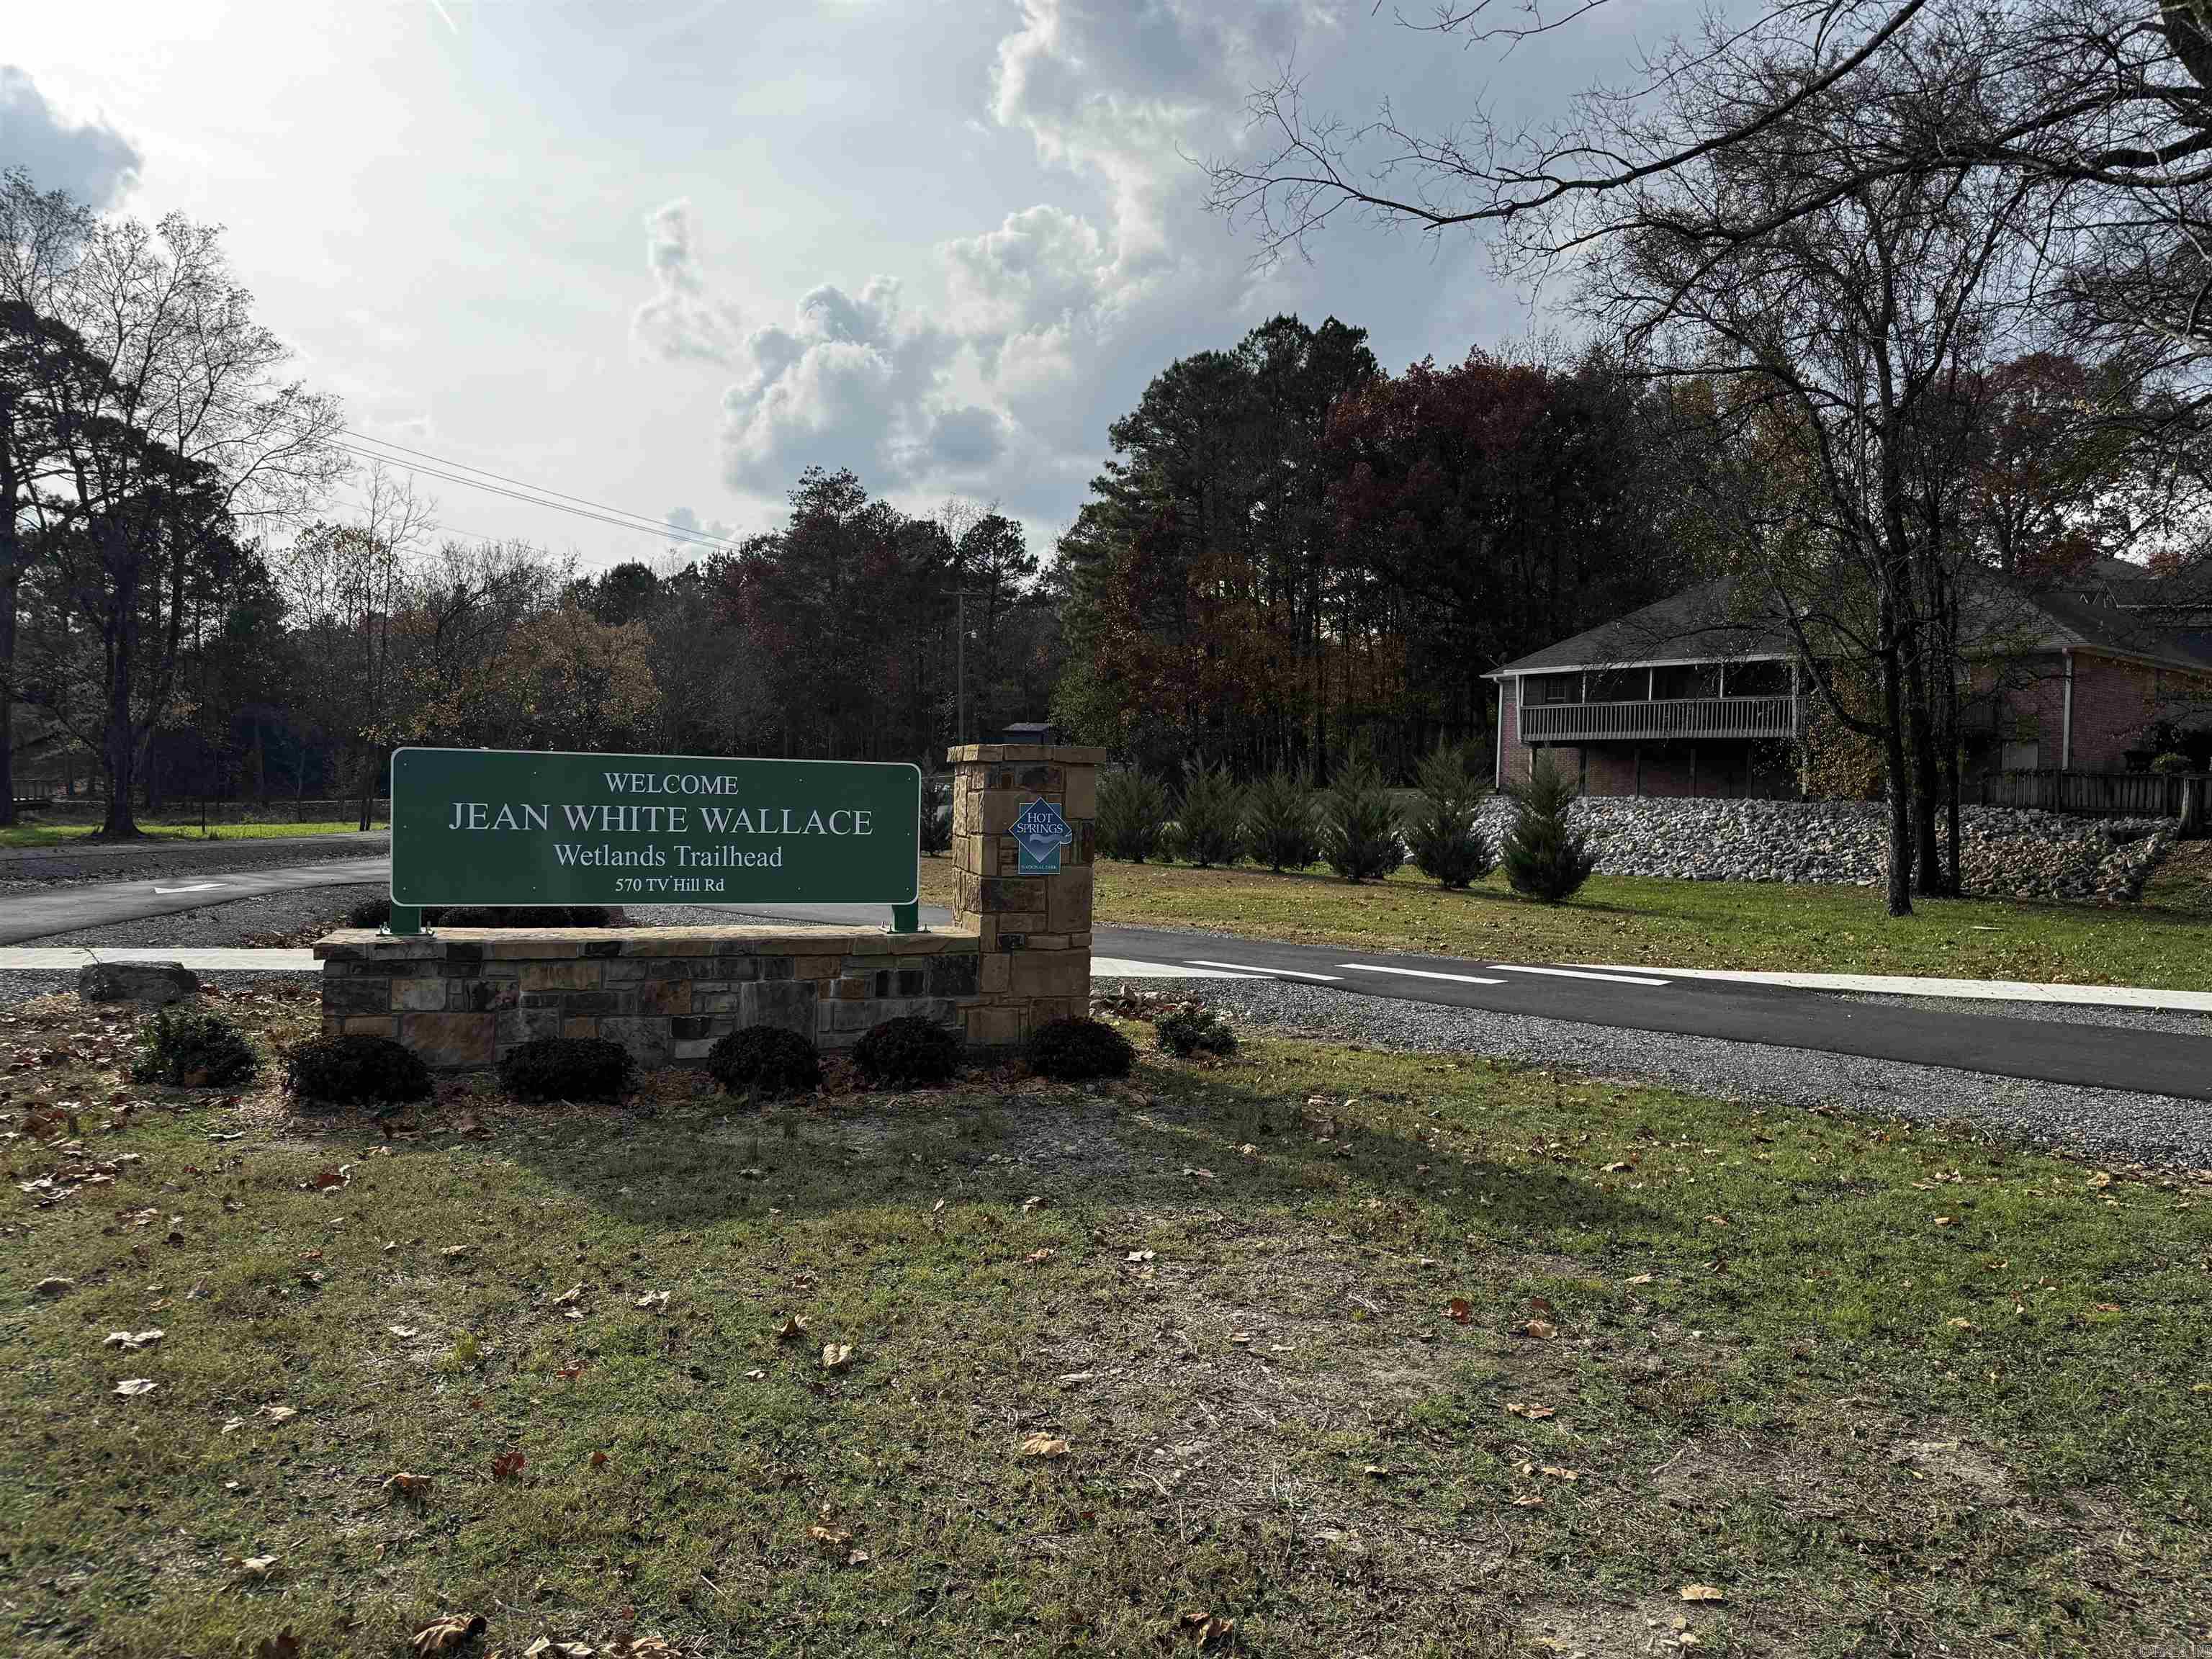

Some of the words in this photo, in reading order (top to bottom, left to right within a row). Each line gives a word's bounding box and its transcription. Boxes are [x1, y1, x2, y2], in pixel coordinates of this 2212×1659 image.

[603, 773, 739, 795] WELCOME
[449, 802, 550, 830] JEAN
[561, 804, 688, 832] WHITE
[698, 807, 873, 835] WALLACE
[1028, 812, 1053, 823] HOT
[1017, 823, 1064, 834] SPRINGS
[552, 844, 666, 867] Wetlands
[673, 845, 783, 868] Trailhead
[615, 878, 642, 892] 570
[645, 878, 670, 891] TV
[672, 877, 701, 891] Hill
[704, 878, 725, 891] Rd
